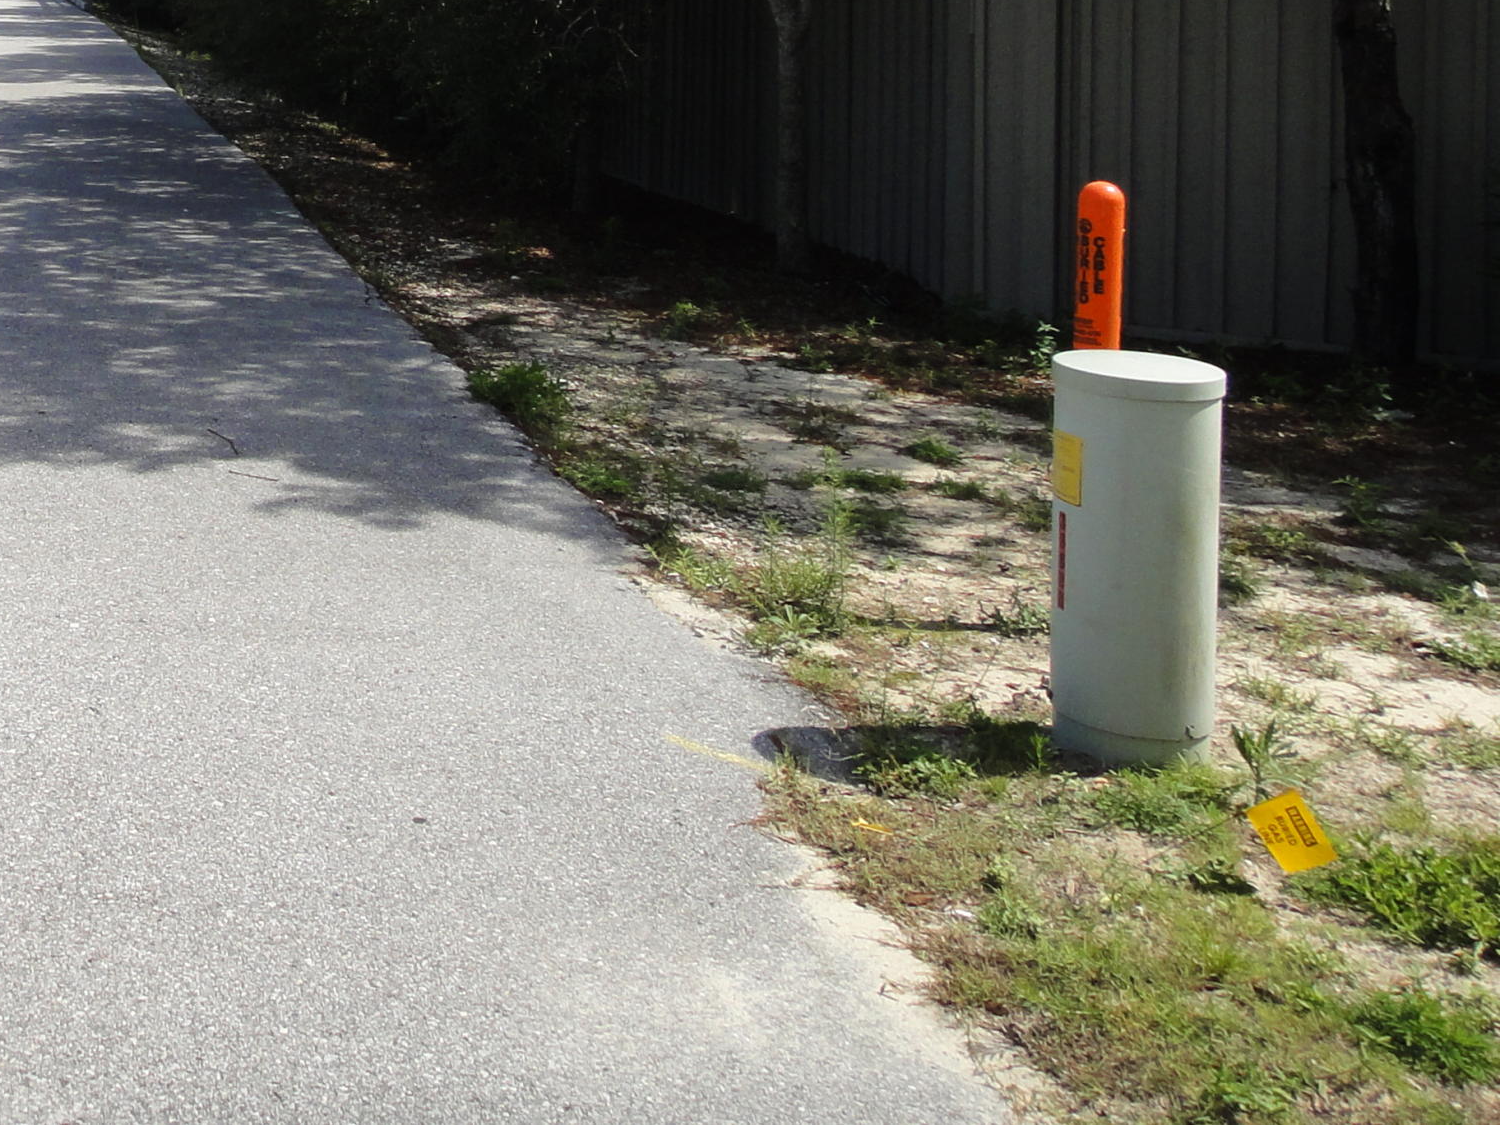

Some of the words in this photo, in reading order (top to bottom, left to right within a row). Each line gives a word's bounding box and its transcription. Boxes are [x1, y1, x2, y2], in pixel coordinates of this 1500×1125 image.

[1079, 236, 1089, 304] BURIED
[1093, 236, 1105, 294] CABLE
[1267, 824, 1284, 843] GAS
[1275, 816, 1296, 845] BURIED
[1287, 808, 1316, 846] WARNING
